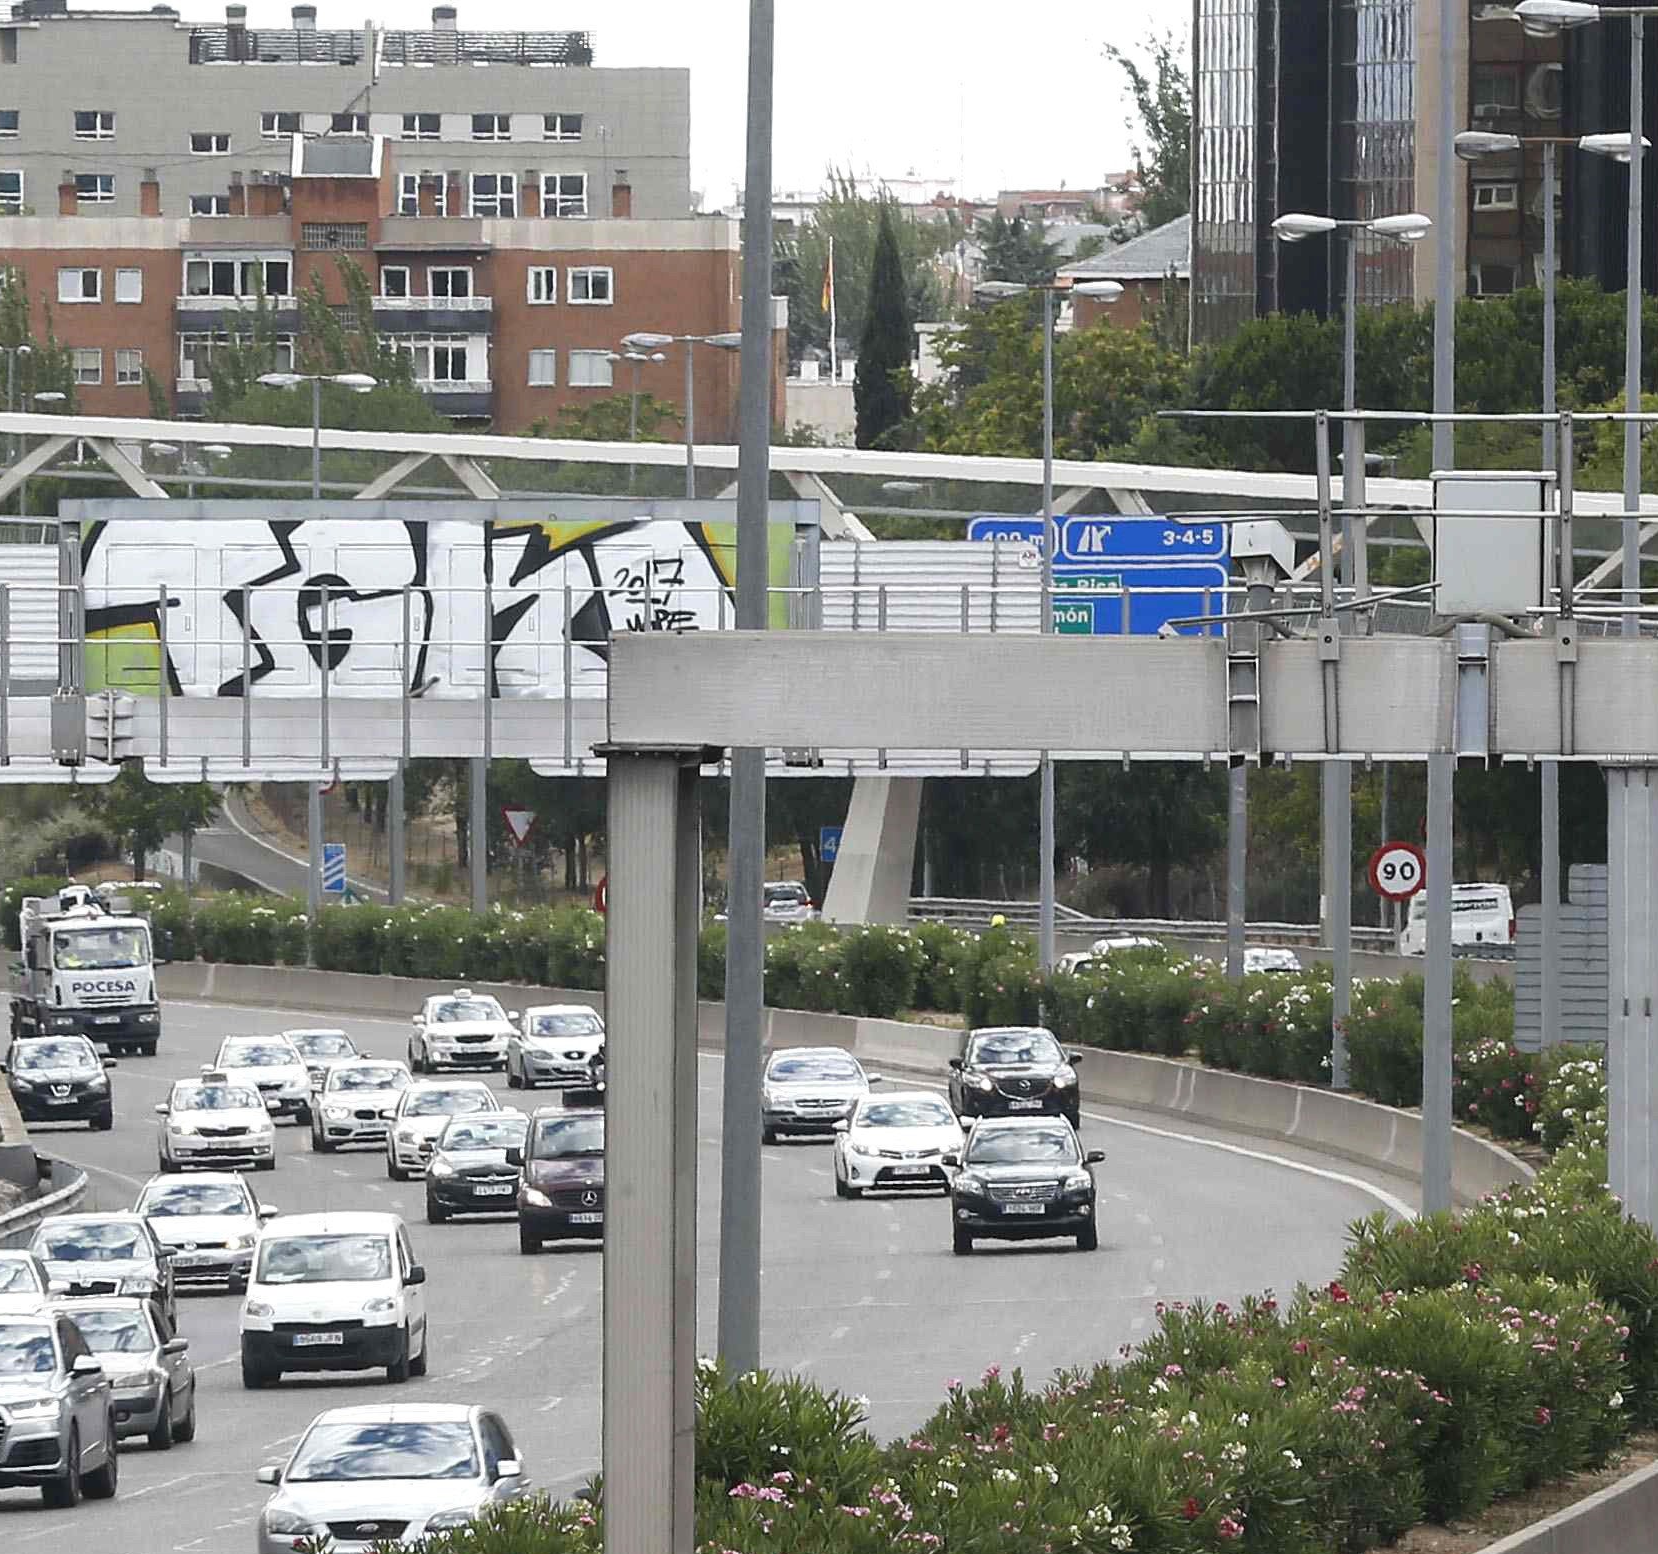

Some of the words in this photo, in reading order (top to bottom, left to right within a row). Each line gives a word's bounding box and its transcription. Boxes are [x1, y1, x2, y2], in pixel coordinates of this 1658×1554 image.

[608, 560, 685, 606] 2017
[1383, 862, 1416, 881] 90
[72, 981, 136, 993] POCESA
